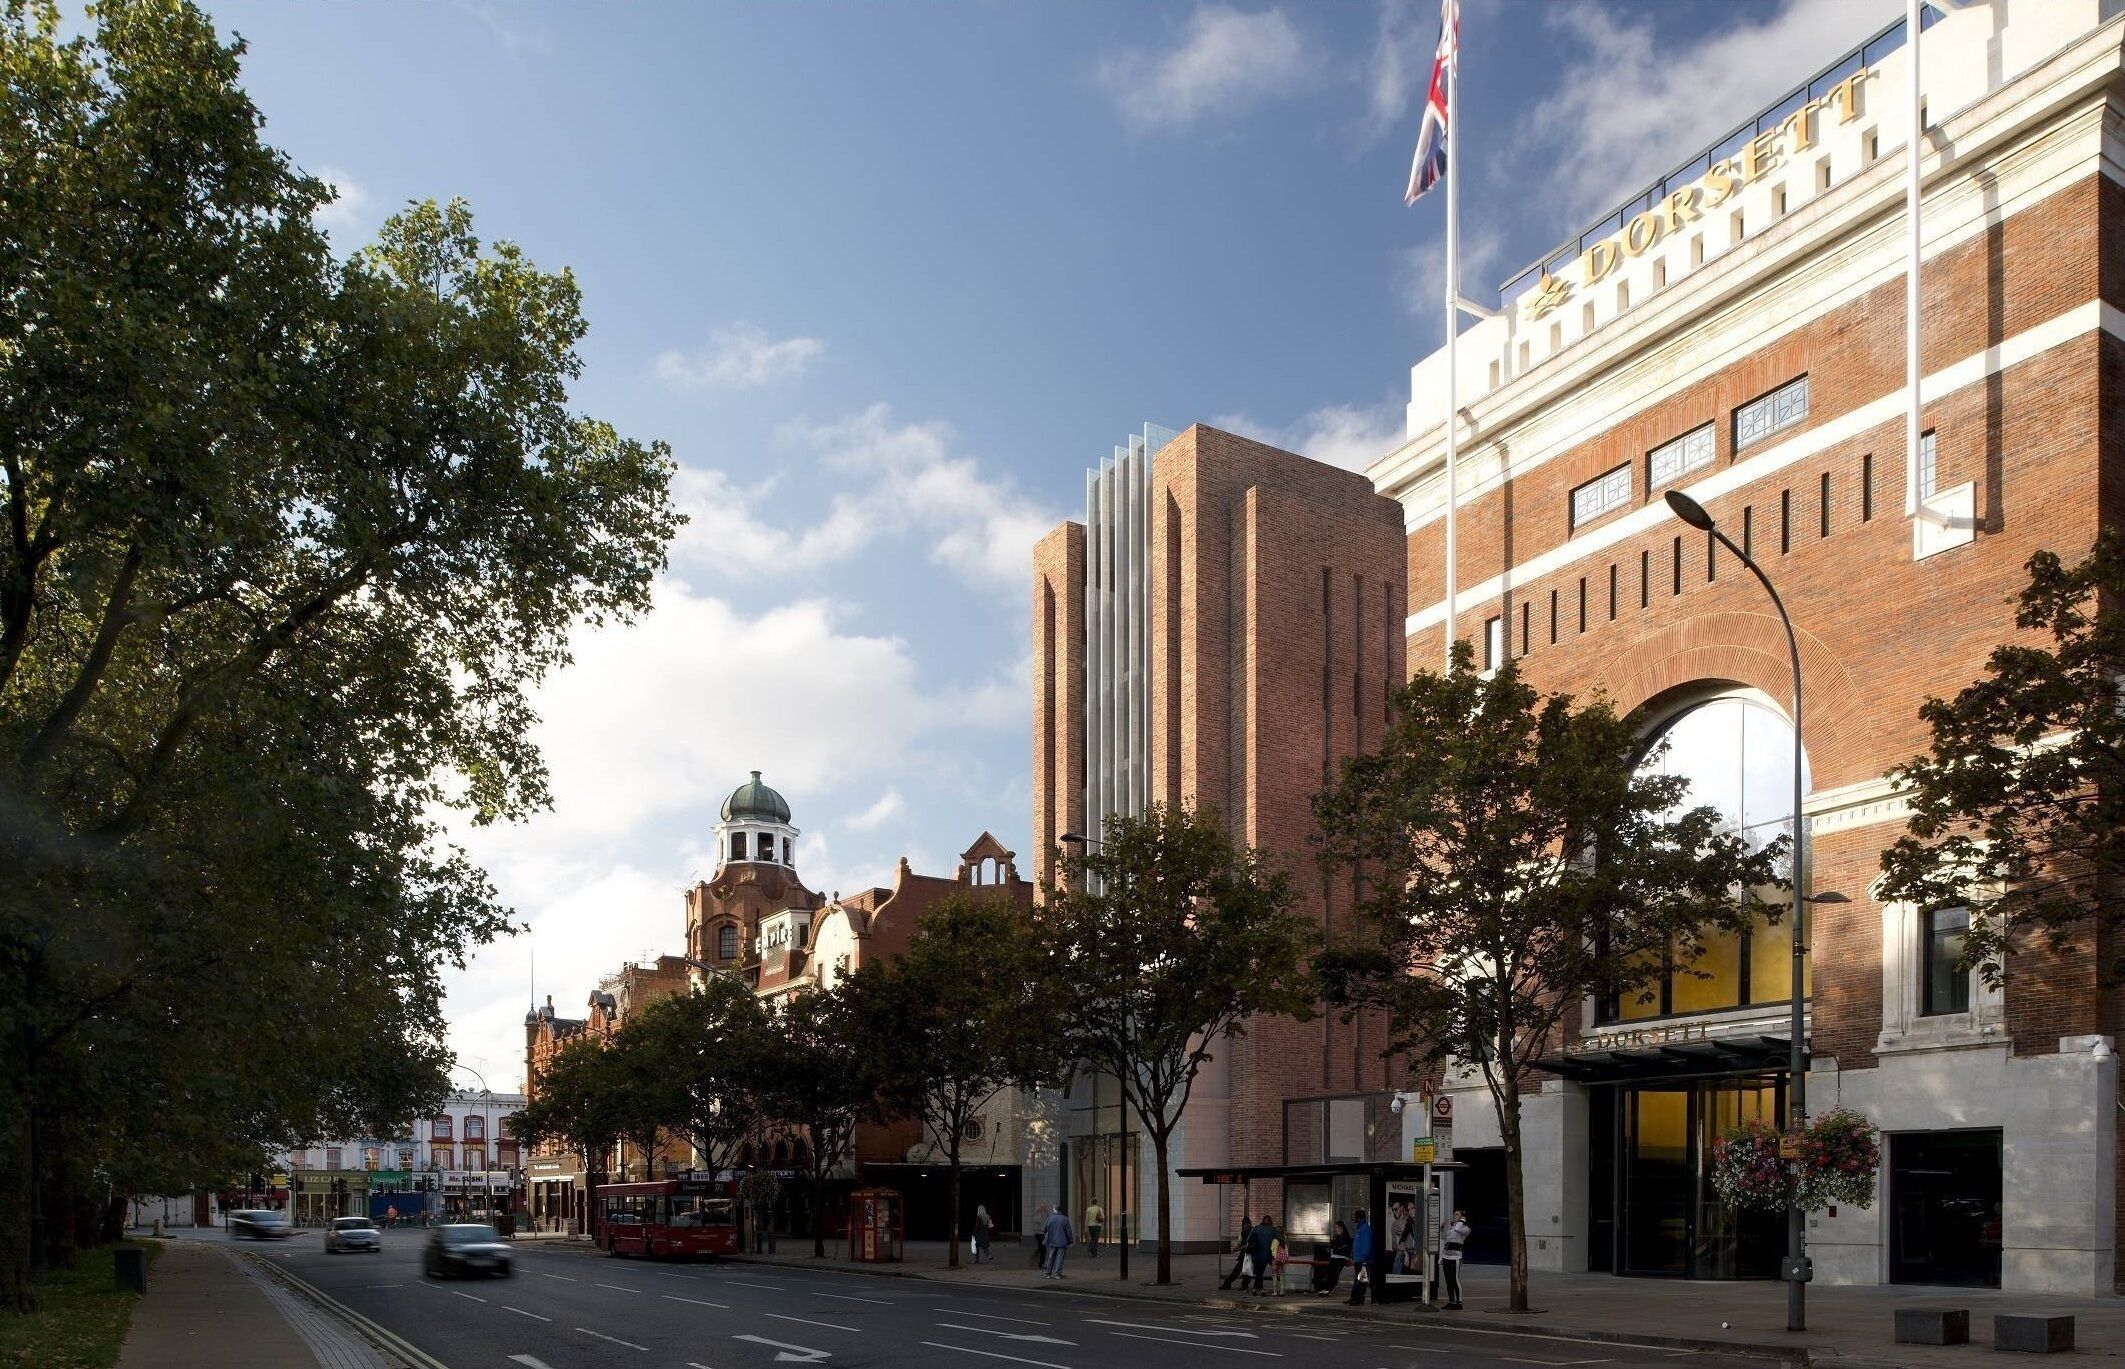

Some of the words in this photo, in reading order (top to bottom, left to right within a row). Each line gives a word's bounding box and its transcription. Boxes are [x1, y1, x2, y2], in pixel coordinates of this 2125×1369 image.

[1582, 67, 1868, 288] DORSETT
[755, 925, 792, 954] EMPIRE
[1598, 1021, 1711, 1049] DORSETT
[1392, 1183, 1414, 1191] MICHAEL
